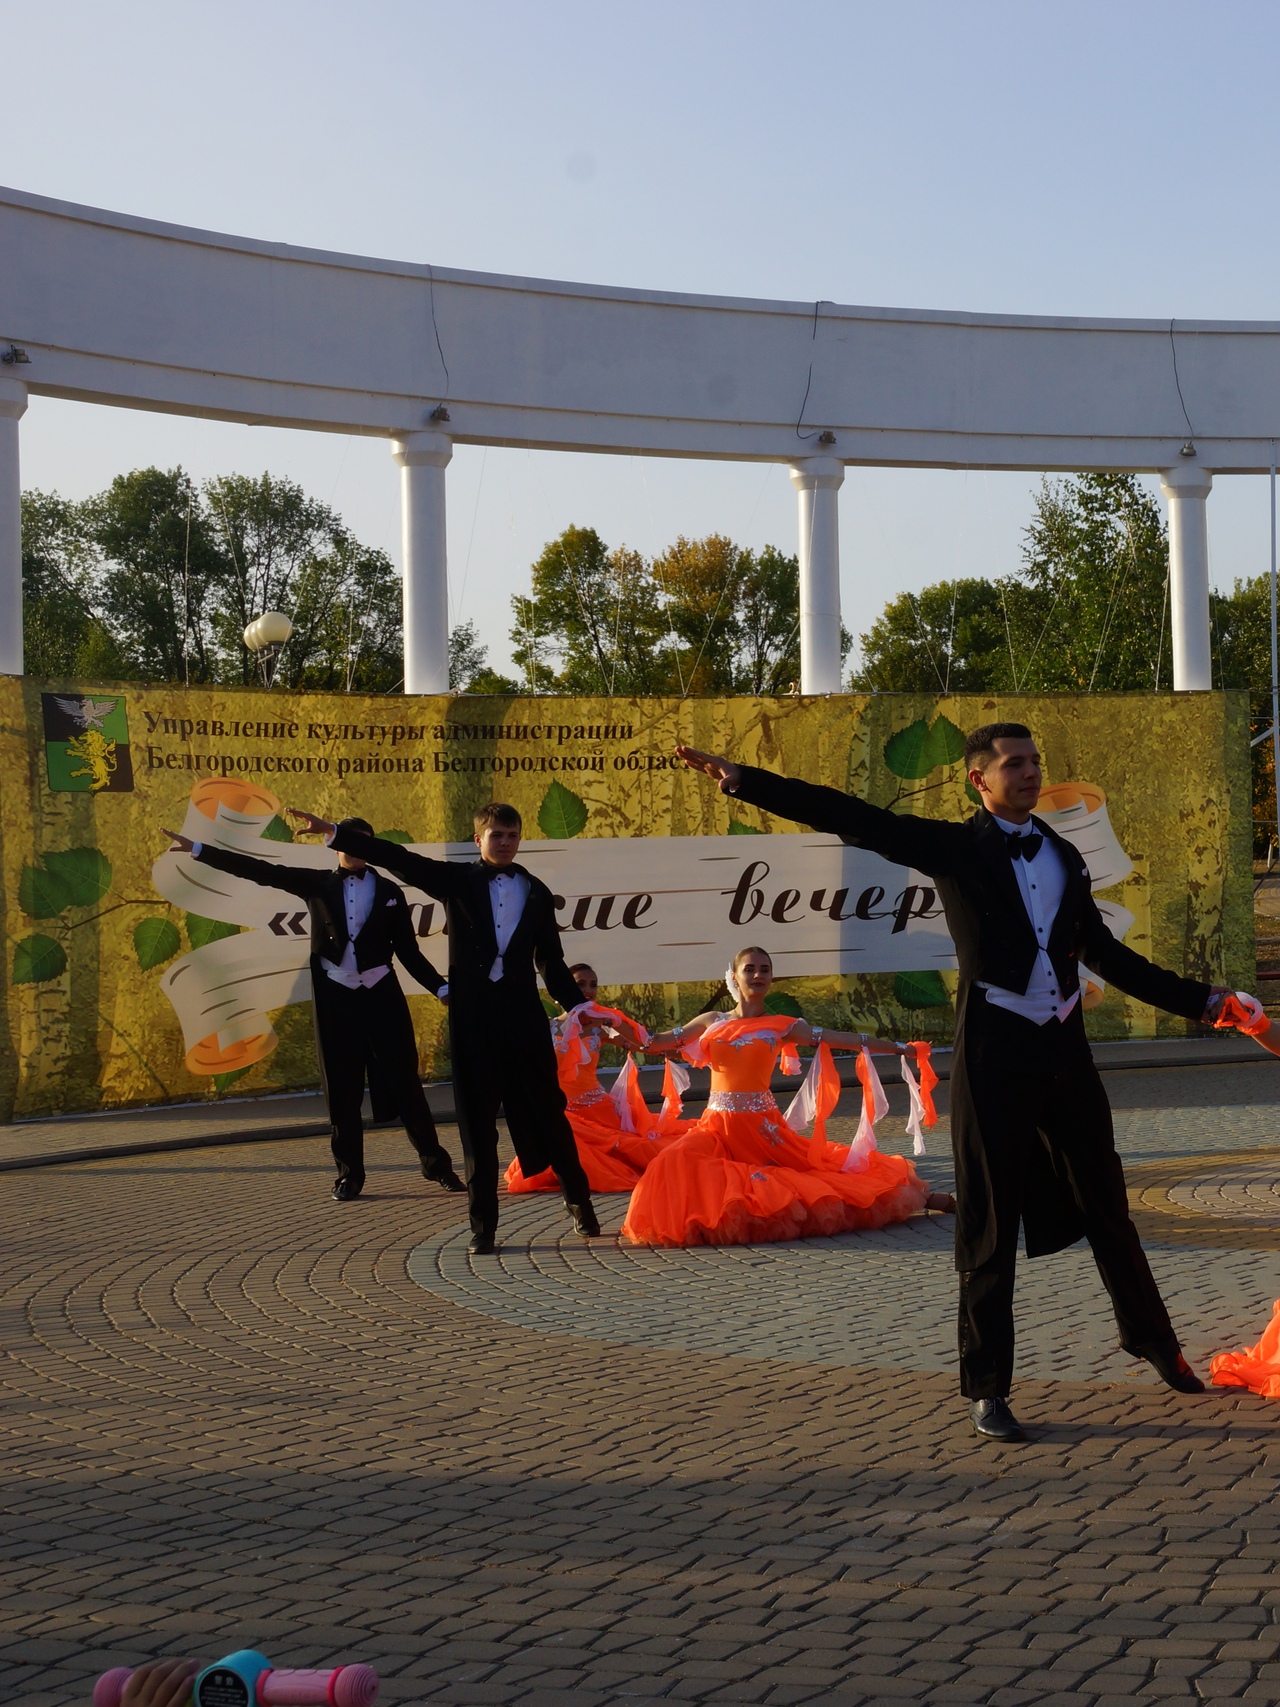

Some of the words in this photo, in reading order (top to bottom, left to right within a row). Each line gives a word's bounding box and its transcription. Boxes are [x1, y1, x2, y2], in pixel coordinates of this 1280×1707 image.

[143, 710, 299, 741] Управление
[306, 723, 426, 746] культуры
[433, 724, 633, 745] администрации
[147, 746, 329, 777] Белгородского
[338, 752, 424, 780] района
[432, 751, 604, 777] Белгородской
[613, 749, 690, 771] облас
[720, 860, 945, 935] вечер
